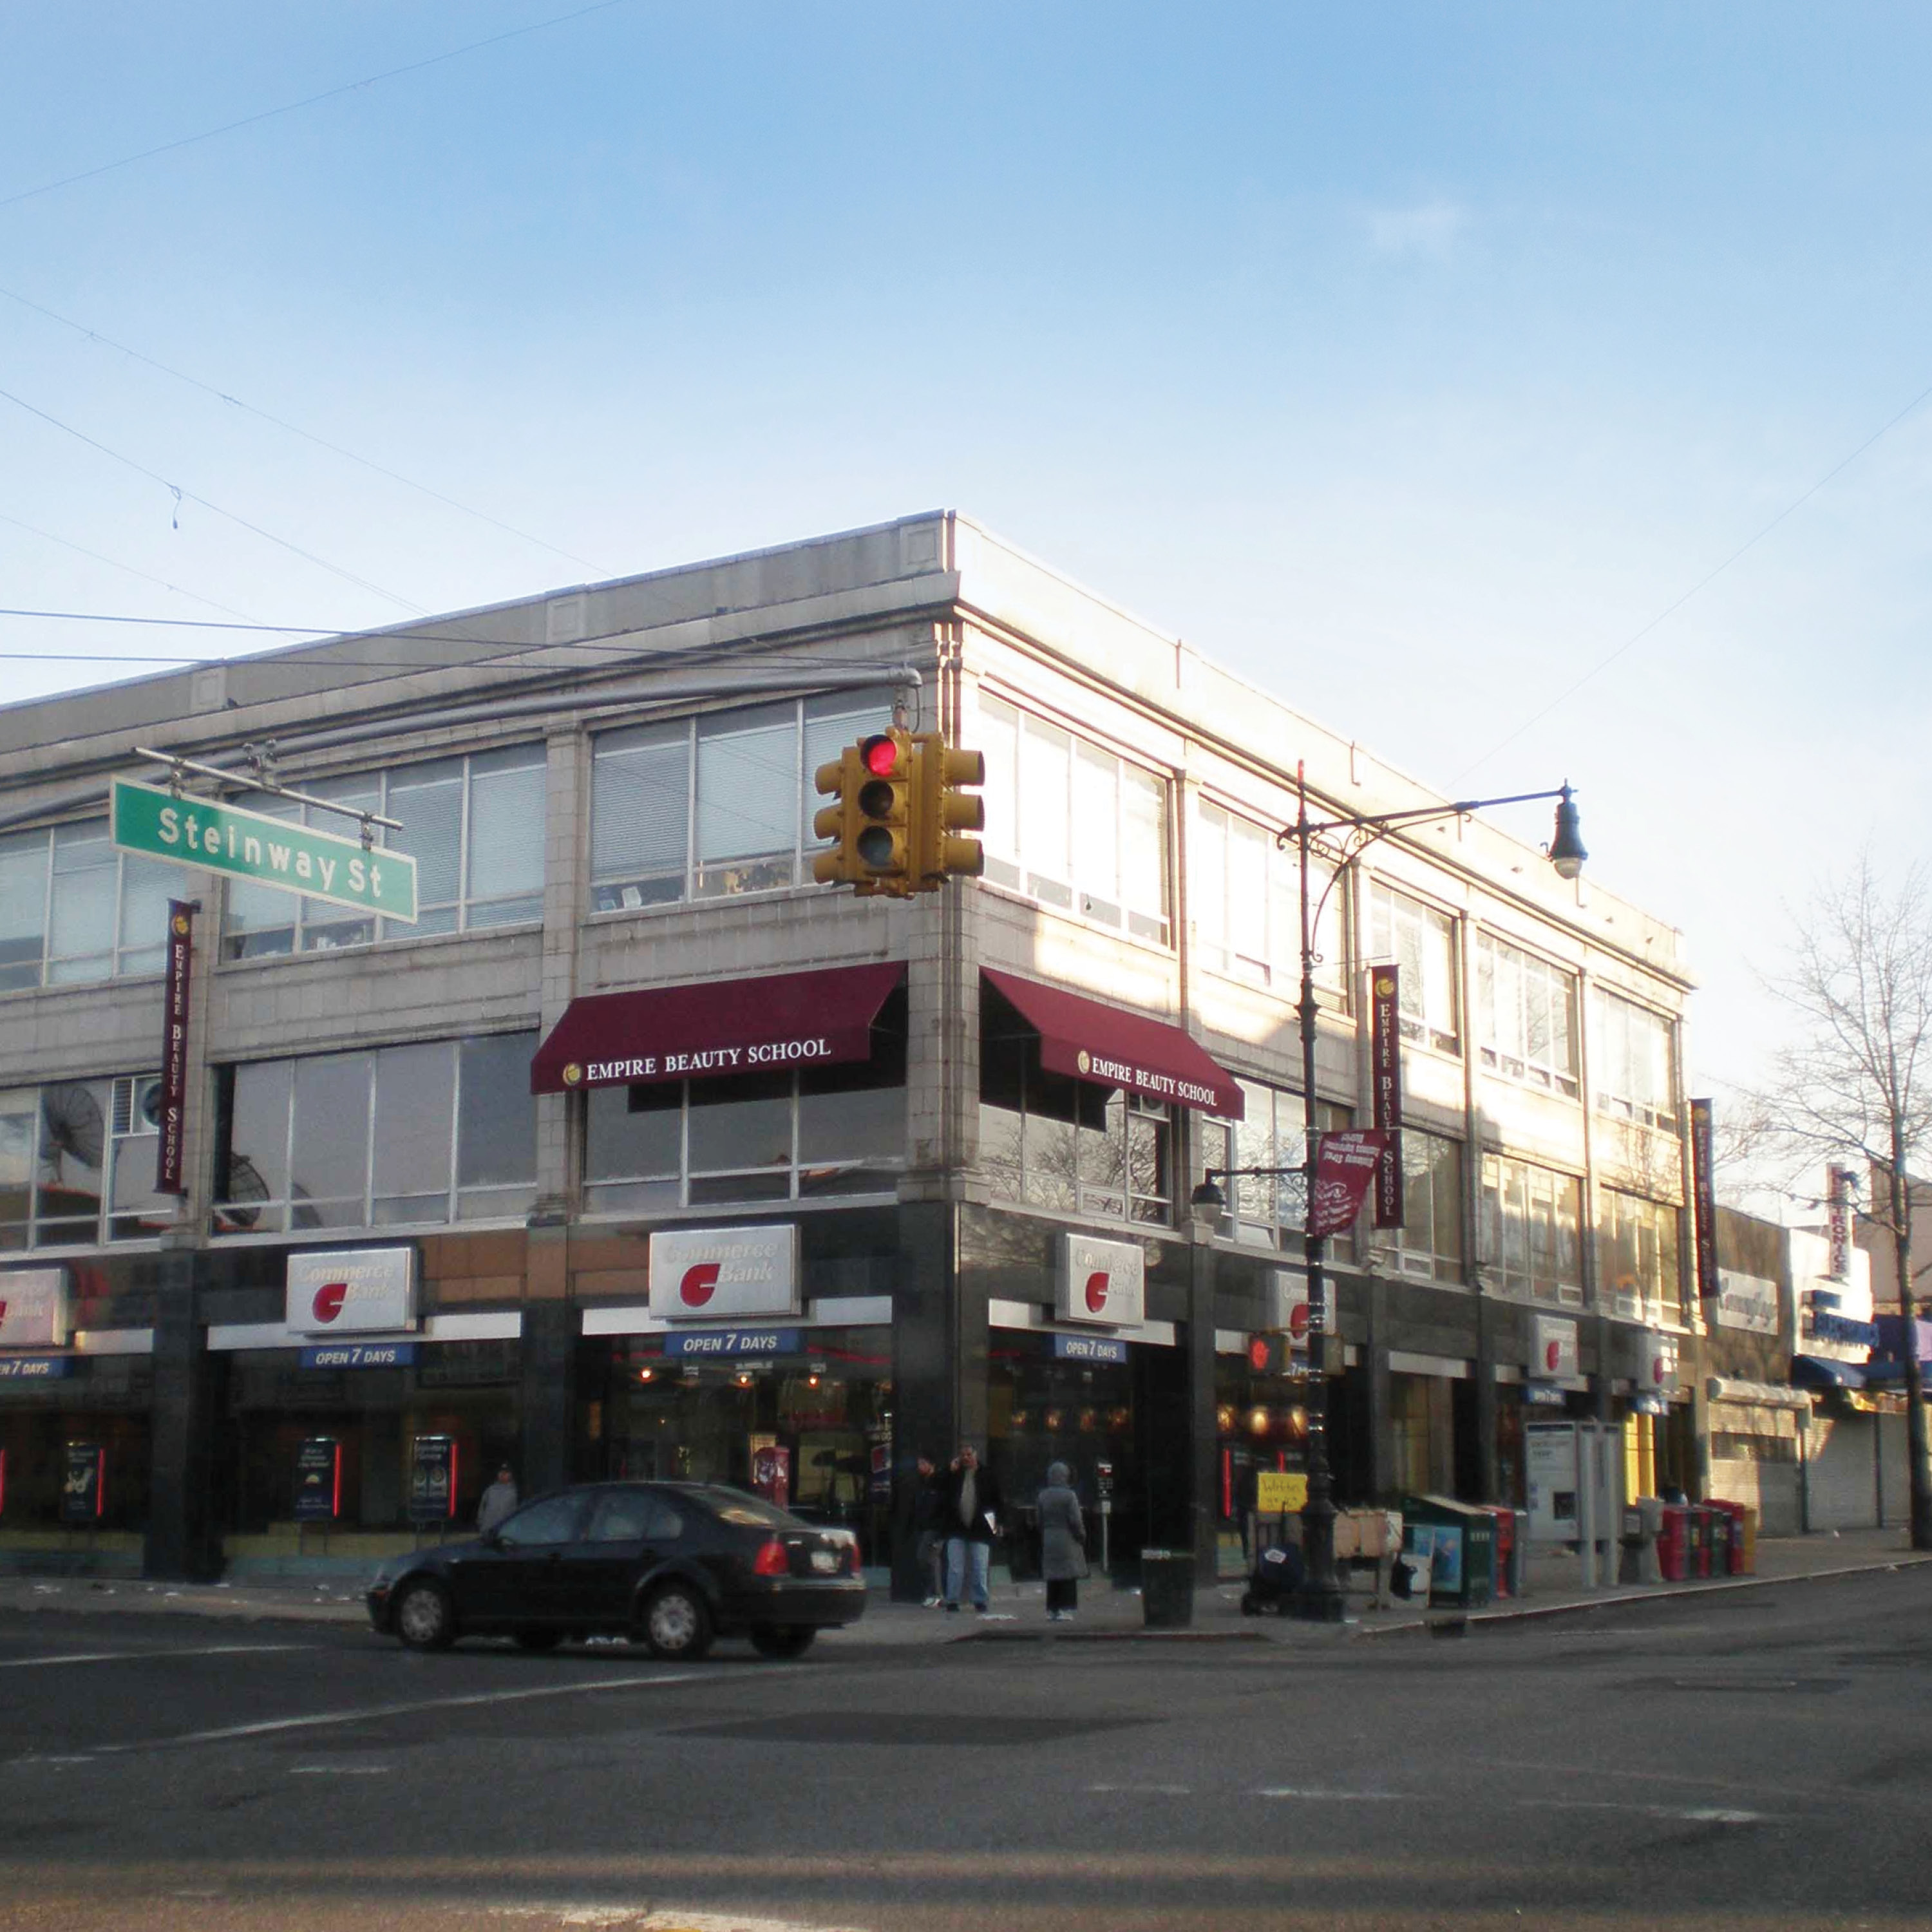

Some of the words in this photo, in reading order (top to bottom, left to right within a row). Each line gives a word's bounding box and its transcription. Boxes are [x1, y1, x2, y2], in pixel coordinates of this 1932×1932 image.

[158, 808, 336, 891] Steinway
[348, 858, 381, 898] St
[174, 944, 185, 1016] EMPIRE
[171, 1024, 182, 1097] BEAUTY
[586, 1058, 656, 1081] EMPIRE
[665, 1048, 741, 1073] BEAUTY
[748, 1038, 831, 1064] SCHOOL
[1379, 1003, 1392, 1068] EMPIRE
[1092, 1057, 1132, 1083] EMPIRE
[1135, 1069, 1177, 1095] BEAUTY
[1178, 1081, 1218, 1106] SCHOOL
[1381, 1076, 1393, 1142] BEAUTY
[165, 1107, 178, 1180] SCHOOL
[1383, 1150, 1394, 1217] SCHOOL
[719, 1261, 773, 1283] Bank
[12, 1360, 21, 1376] 7
[21, 1361, 50, 1376] DAYS
[316, 1351, 348, 1365] OPEN
[352, 1347, 362, 1363] 7
[363, 1349, 395, 1363] DAYS
[683, 1338, 722, 1352] OPEN
[726, 1334, 737, 1350] 7
[741, 1335, 778, 1350] DAYS
[1066, 1341, 1088, 1356] OPEN
[1088, 1341, 1097, 1356] 7
[1097, 1345, 1118, 1359] DAYS
